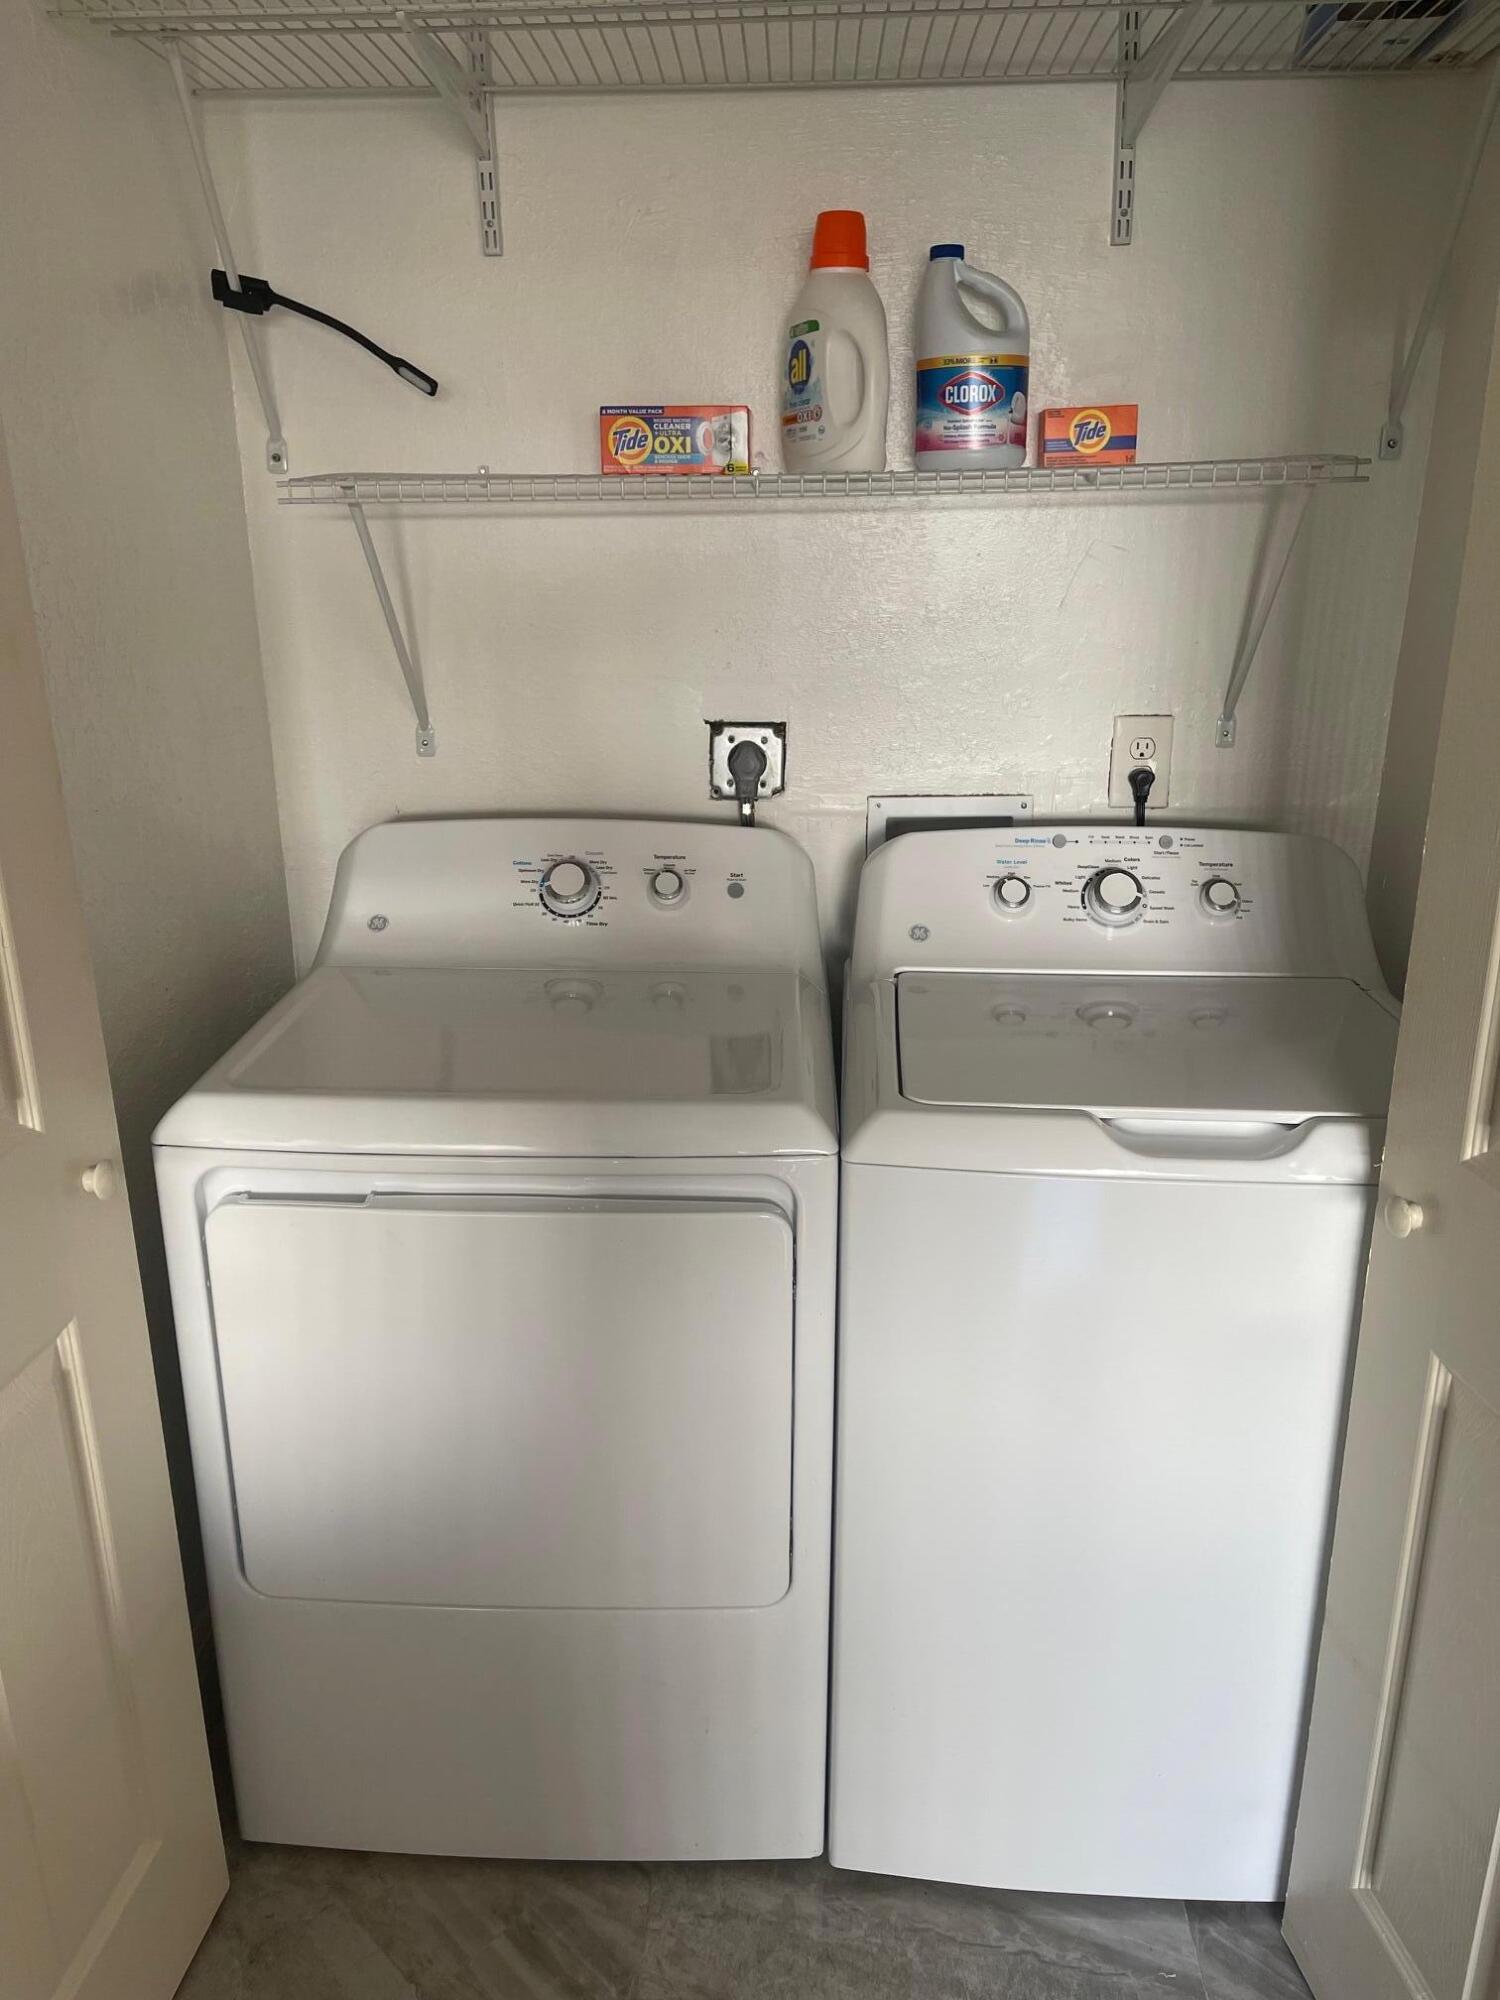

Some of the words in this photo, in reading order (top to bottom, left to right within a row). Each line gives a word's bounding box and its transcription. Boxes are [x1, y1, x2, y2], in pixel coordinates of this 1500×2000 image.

[790, 348, 807, 383] all
[945, 384, 997, 404] CLOROX
[612, 427, 649, 457] Tide
[654, 436, 692, 454] OXI
[1074, 420, 1107, 447] Tide
